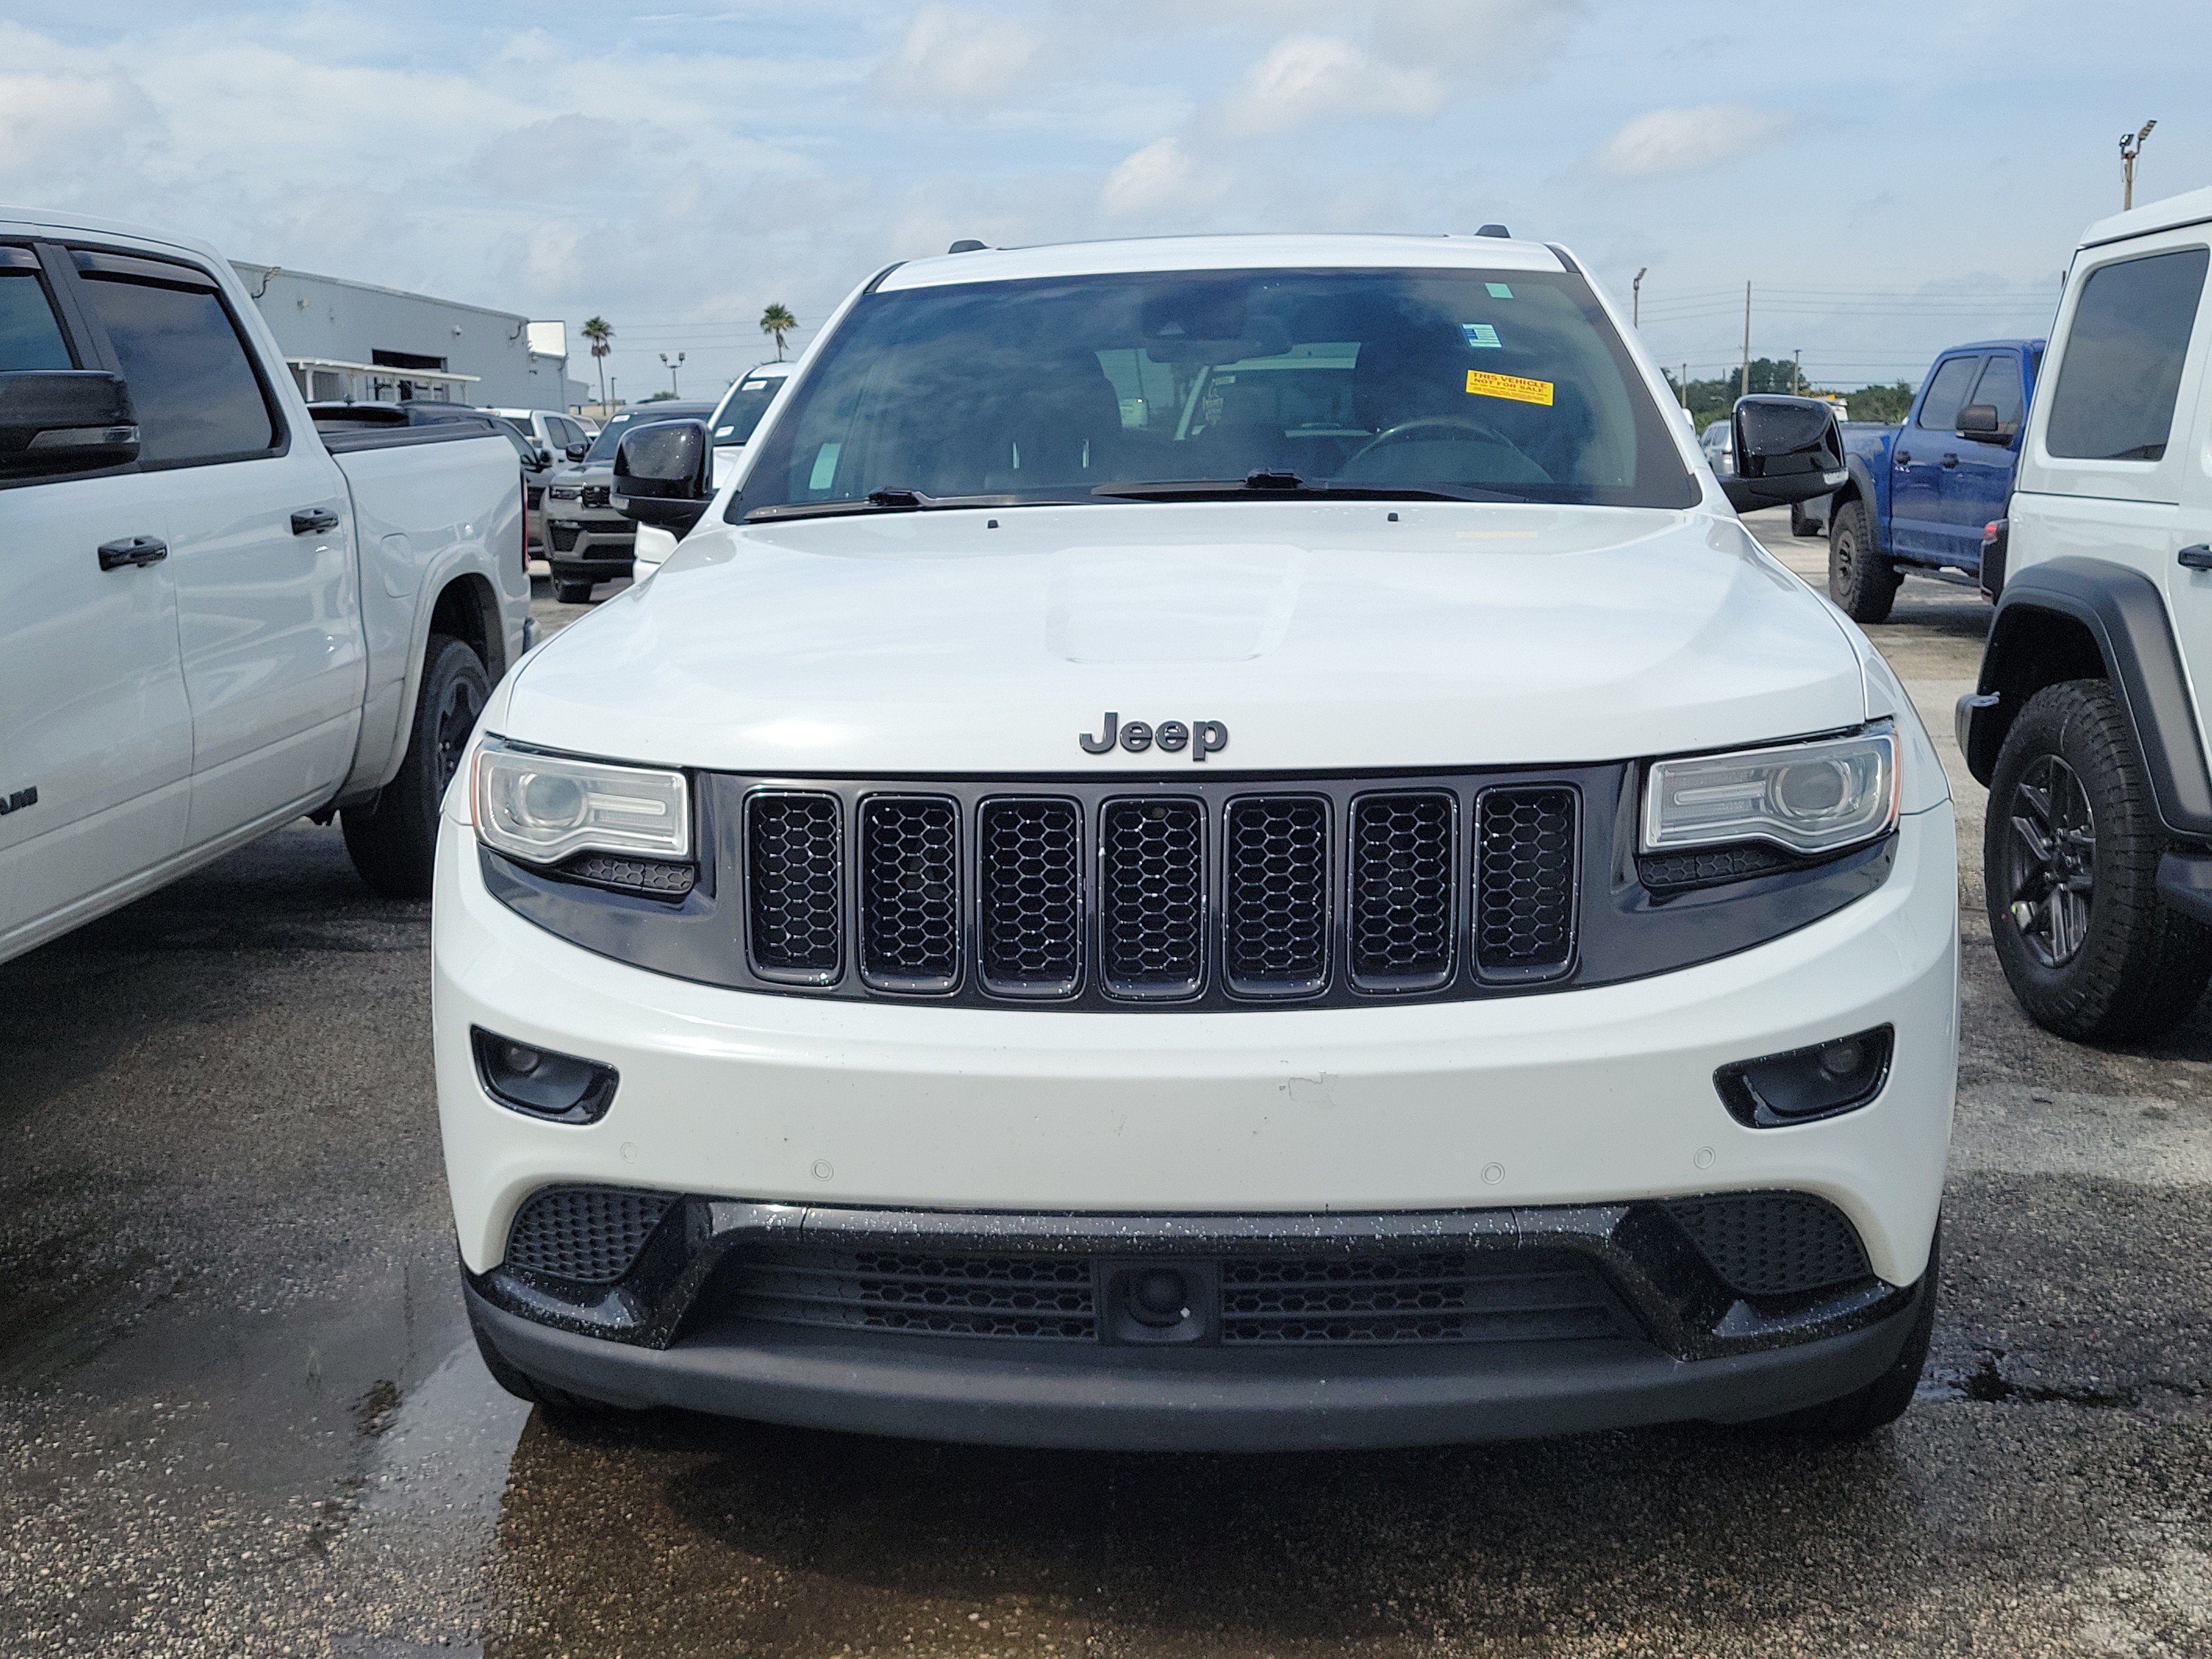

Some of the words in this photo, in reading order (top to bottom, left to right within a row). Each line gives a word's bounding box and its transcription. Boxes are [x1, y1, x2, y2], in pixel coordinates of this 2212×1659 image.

[1473, 372, 1498, 381] THIS
[1500, 376, 1547, 388] VEHICLE
[1079, 712, 1228, 761] Jeep
